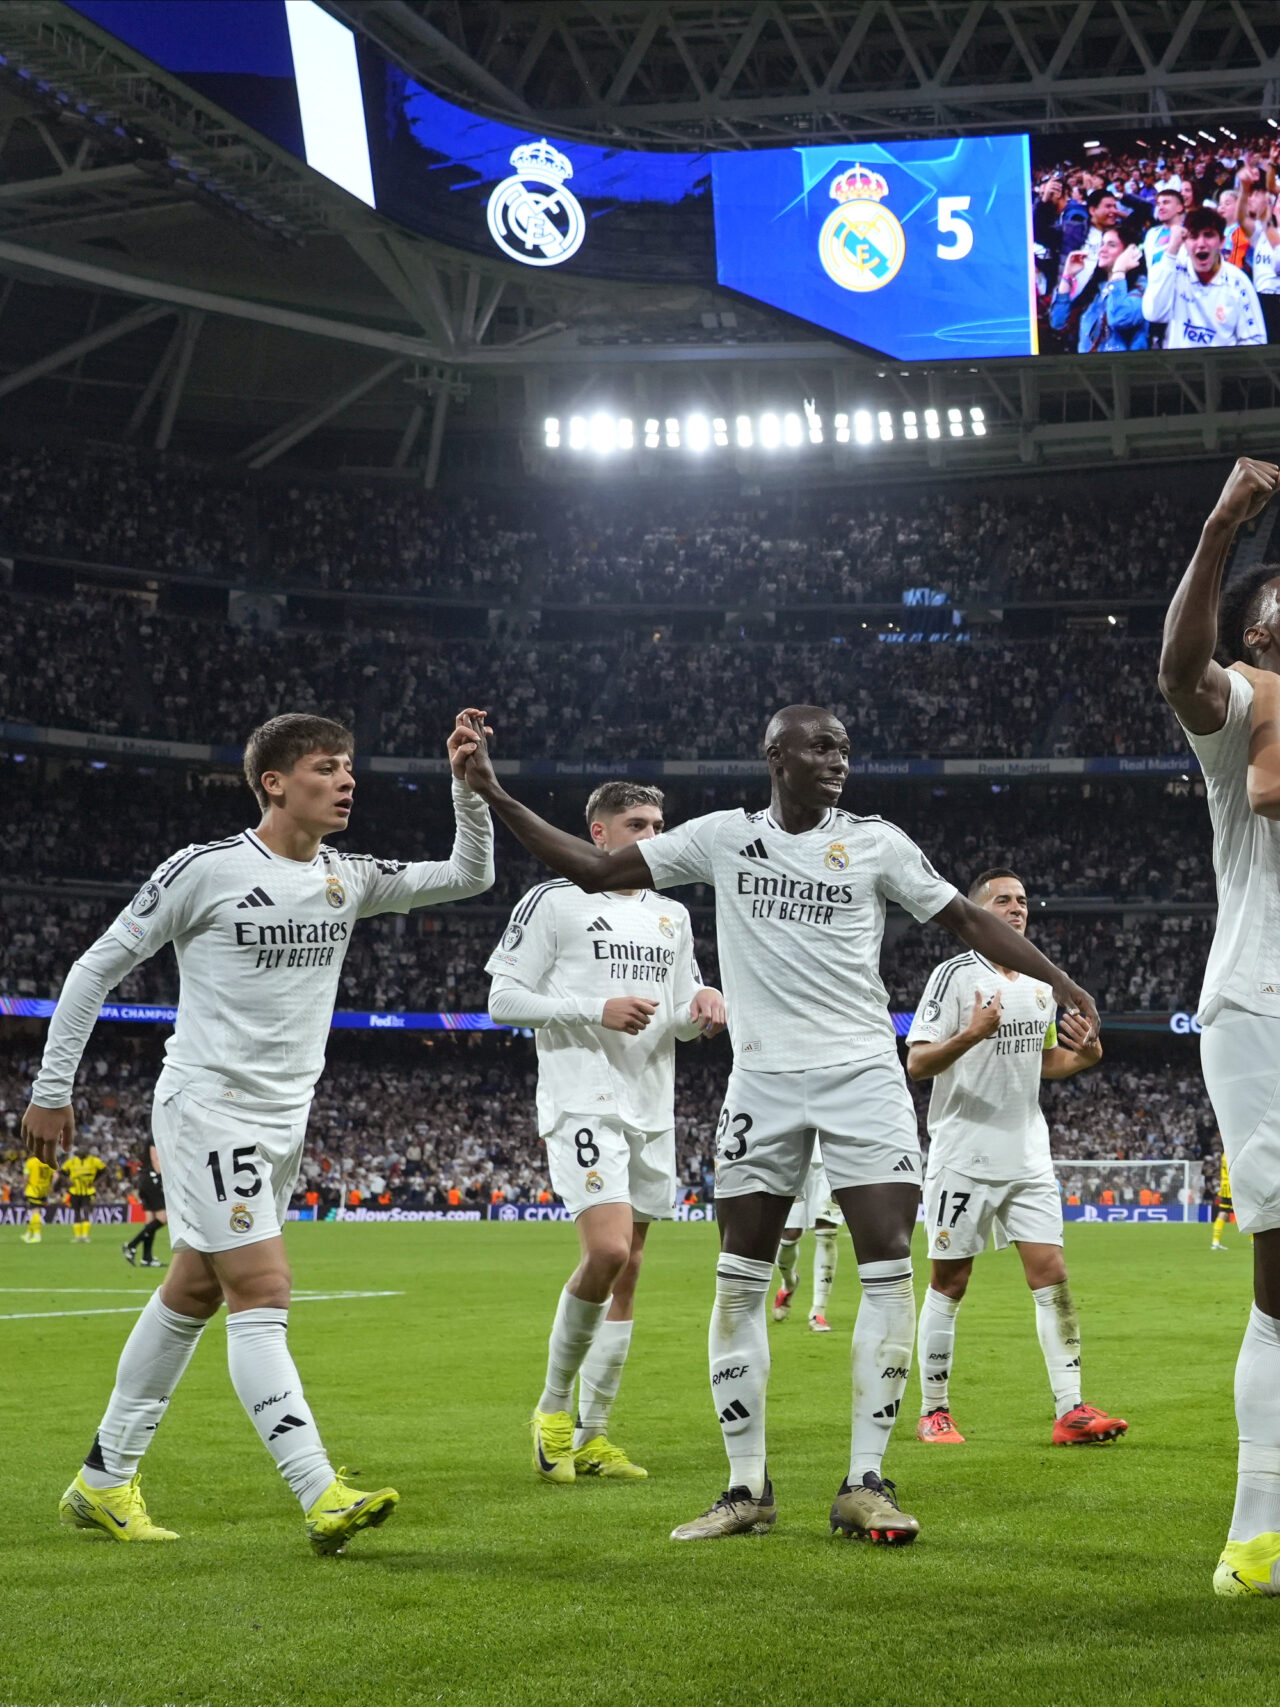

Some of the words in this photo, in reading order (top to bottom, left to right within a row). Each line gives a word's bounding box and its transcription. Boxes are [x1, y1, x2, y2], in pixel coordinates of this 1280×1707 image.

[937, 195, 974, 260] 5
[556, 762, 583, 774] Real
[586, 760, 628, 774] Madrid
[697, 764, 726, 776] Real
[848, 763, 866, 774] eal
[868, 762, 909, 774] Madrid
[978, 764, 1008, 775] Real
[1011, 763, 1050, 775] Madrid
[1119, 760, 1145, 771] Real
[1148, 758, 1190, 770] Madrid
[738, 872, 853, 904] Emirates
[752, 900, 775, 918] FLY
[779, 902, 834, 925] BETTER
[234, 919, 347, 945] Emirates
[256, 948, 285, 968] FLY
[287, 946, 335, 968] BETTER
[592, 940, 675, 966] Emirates
[610, 963, 627, 979] FLY
[632, 965, 668, 984] BETTER
[99, 1008, 119, 1018] EFA
[121, 1009, 178, 1021] CHAMPIO
[369, 1015, 405, 1027] FedEx
[984, 1019, 1049, 1040] mirates
[996, 1039, 1012, 1055] FLY
[575, 1128, 600, 1168] 8
[206, 1145, 262, 1203] 15
[337, 1207, 482, 1222] FollowScores.com
[676, 1204, 713, 1222] Hei
[937, 1190, 971, 1228] 17
[712, 1365, 751, 1387] RMCF
[253, 1391, 293, 1415] RMCF
